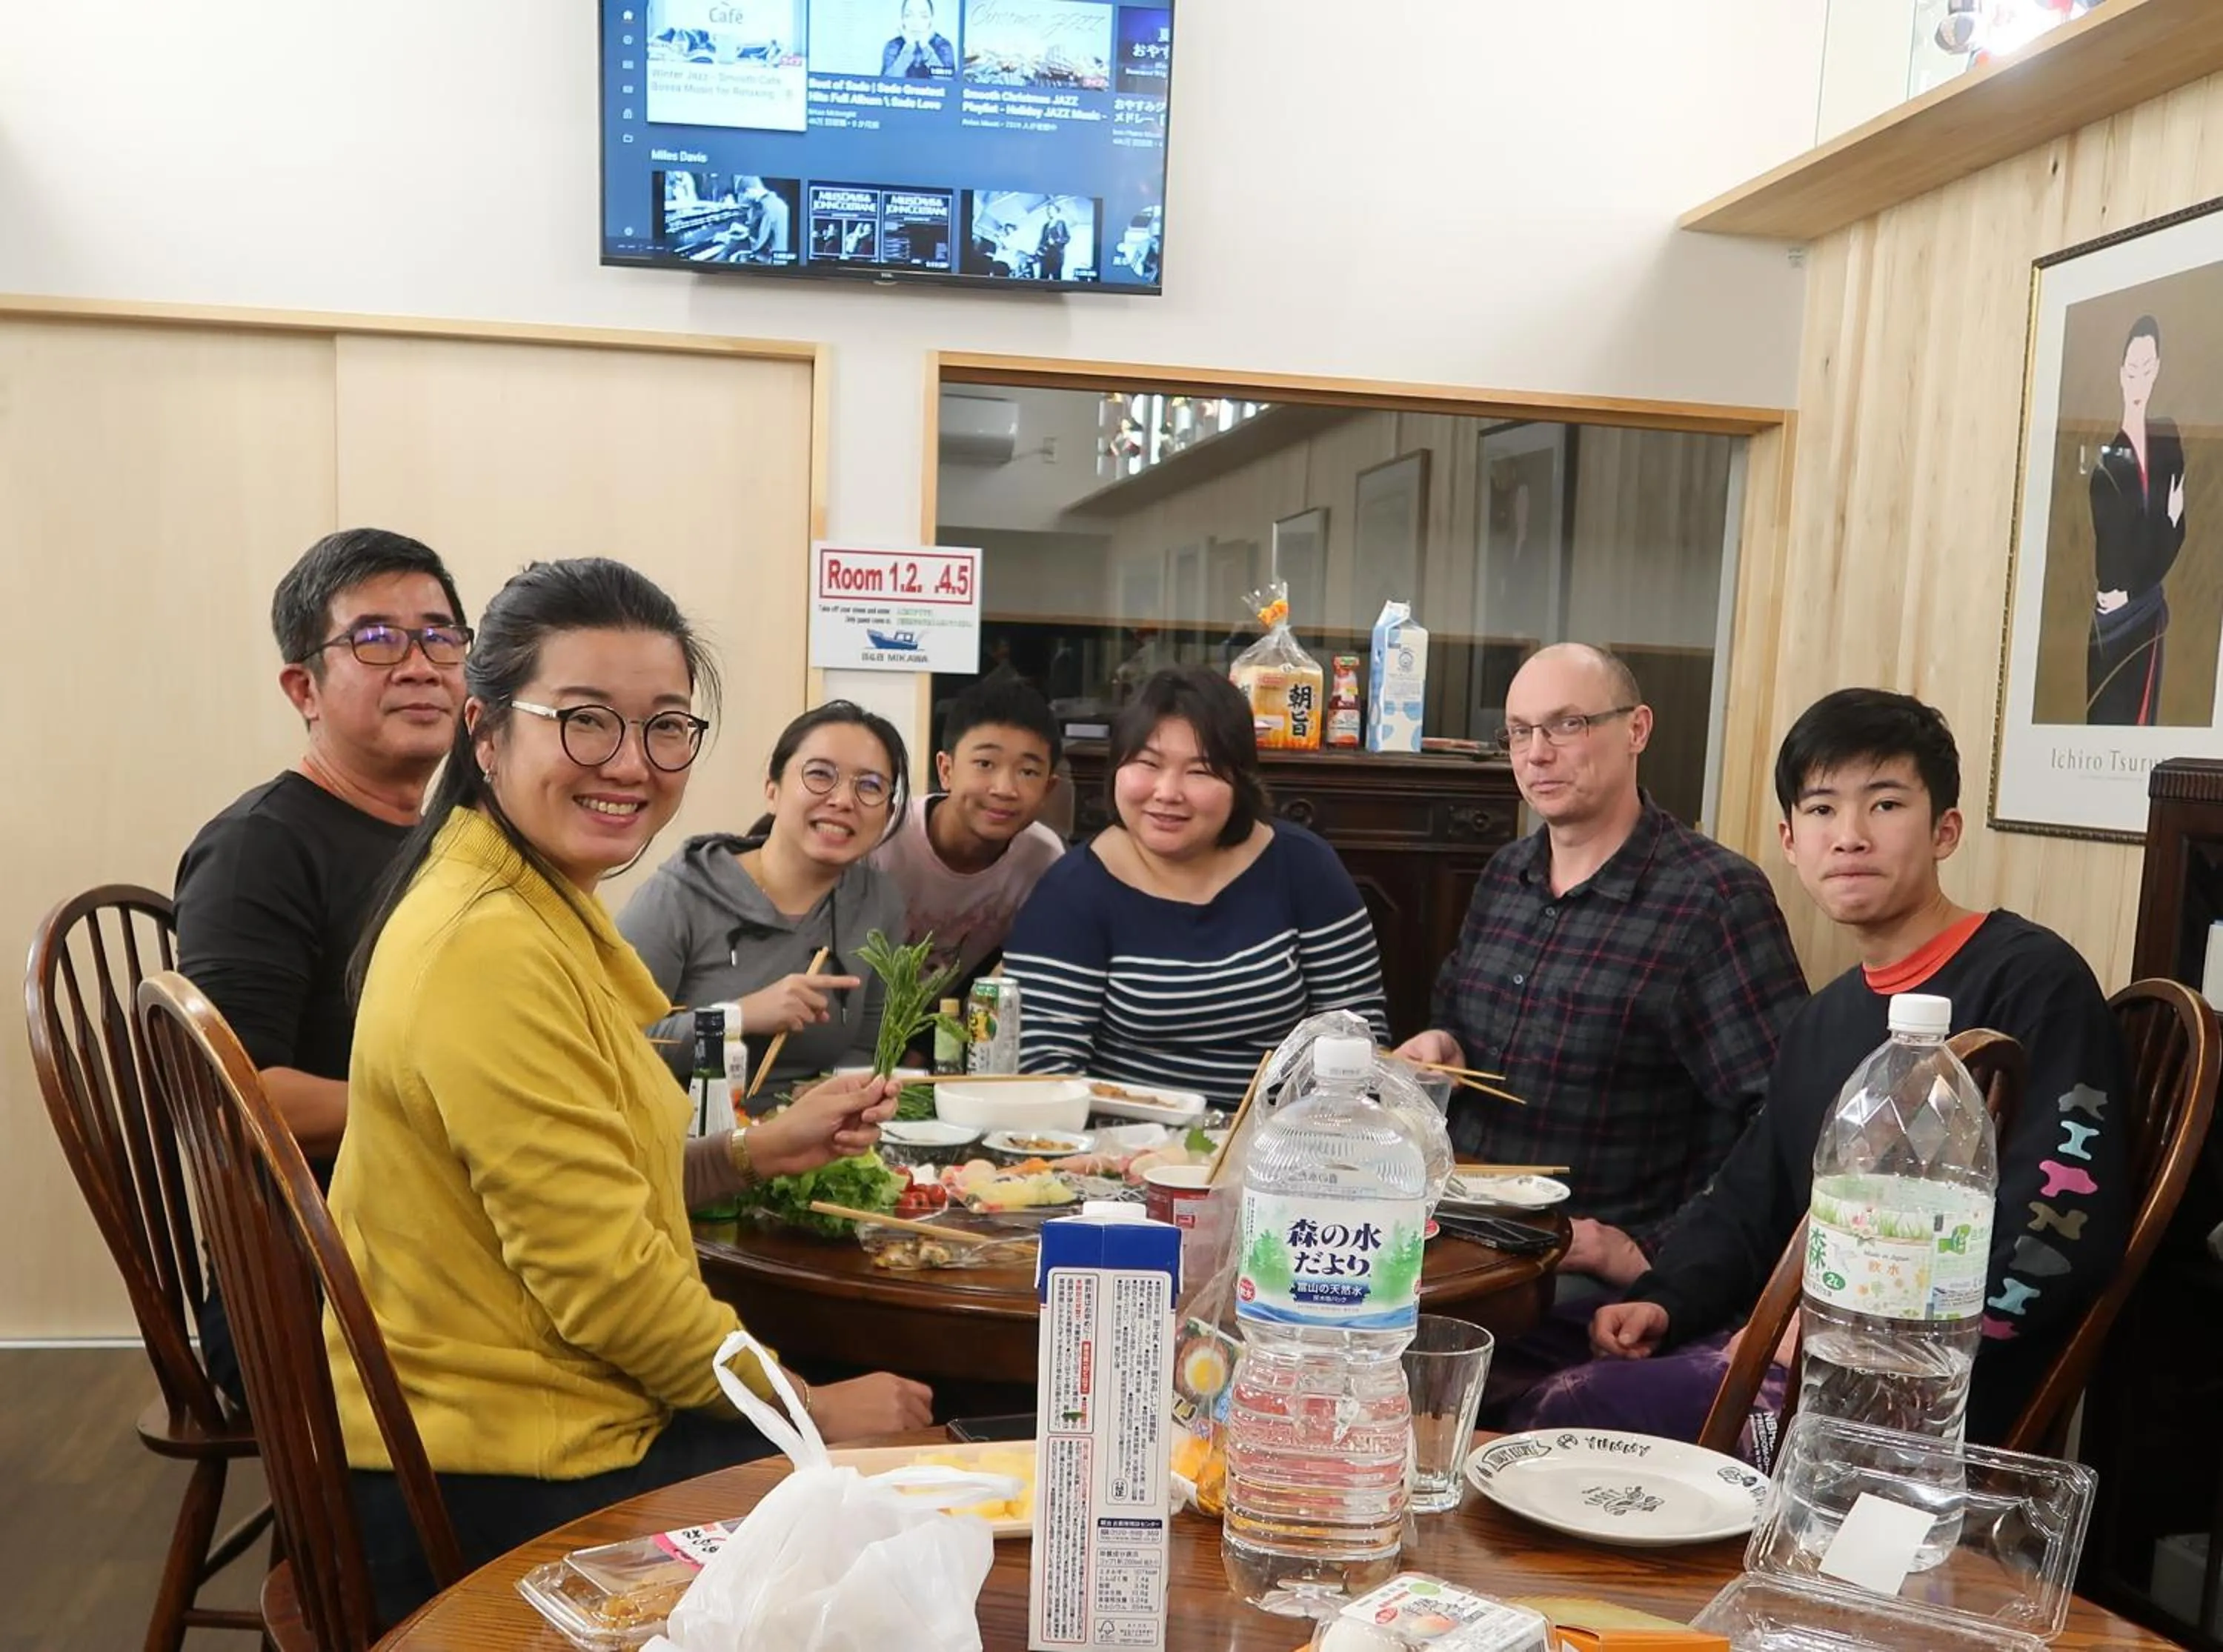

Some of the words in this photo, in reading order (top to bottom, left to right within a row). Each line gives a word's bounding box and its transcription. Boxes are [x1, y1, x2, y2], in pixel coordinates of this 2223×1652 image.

[1051, 95, 1079, 107] JAZZ
[1043, 107, 1072, 119] JAZZ
[651, 148, 678, 161] Miles
[679, 150, 708, 163] Davis
[828, 559, 883, 591] Room
[888, 653, 928, 664] MIKAWA
[2051, 747, 2103, 771] Ichiro
[2110, 750, 2165, 773] Tsuru
[1286, 1219, 1383, 1252] 森の水
[1294, 1251, 1371, 1278] だより
[1297, 1282, 1363, 1296] 富山の天然水
[1585, 1436, 1652, 1457] YUMMY
